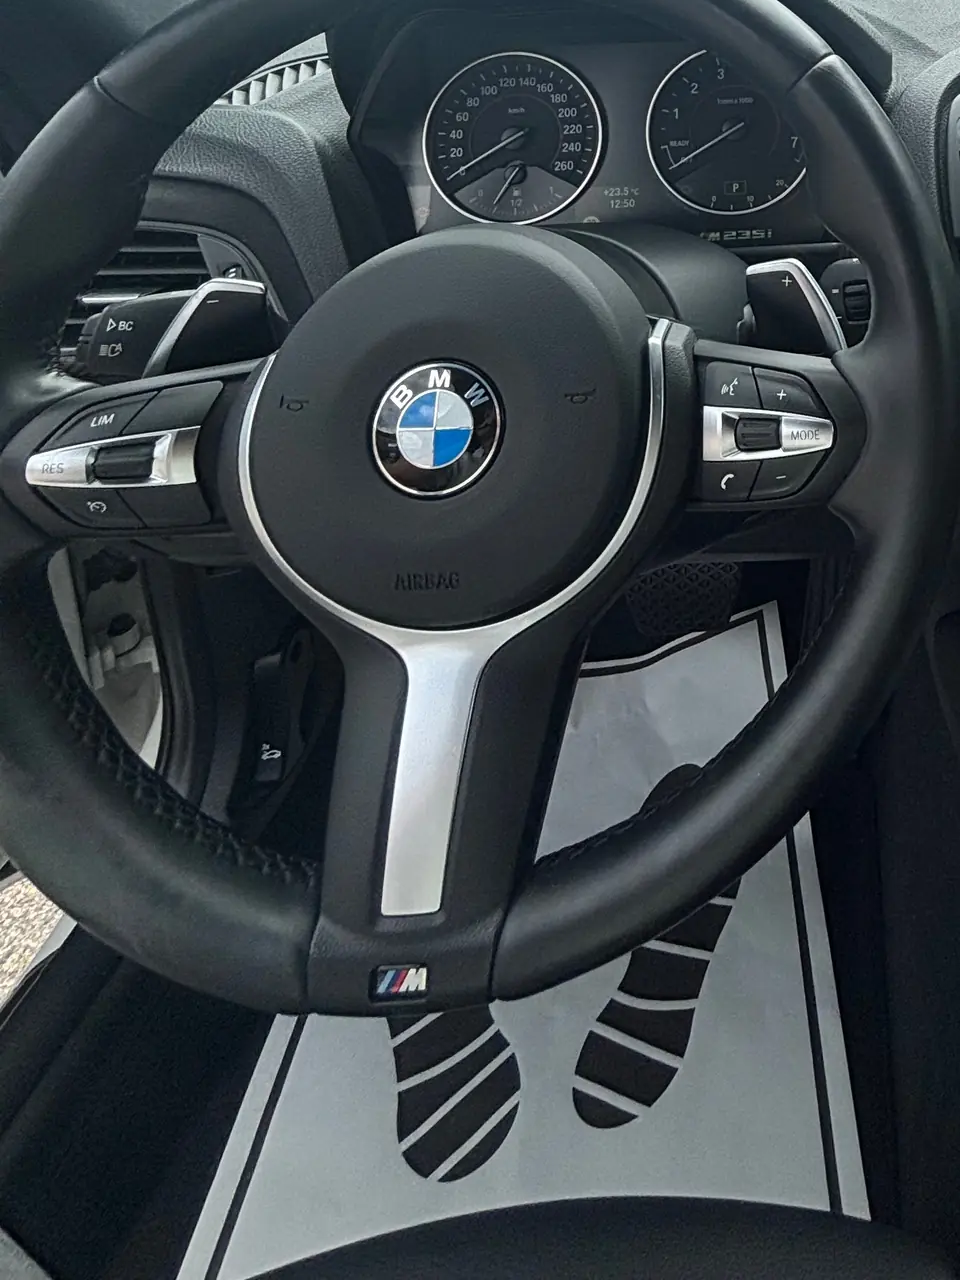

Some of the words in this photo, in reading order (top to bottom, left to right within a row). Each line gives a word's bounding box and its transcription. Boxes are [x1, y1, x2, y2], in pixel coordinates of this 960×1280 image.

[717, 69, 725, 80] 3
[499, 78, 516, 87] 120
[519, 77, 536, 86] 140
[480, 86, 498, 96] 100
[536, 83, 553, 92] 160
[691, 83, 699, 94] 2
[466, 97, 480, 107] 80
[550, 94, 567, 103] 180
[456, 112, 469, 121] 60
[558, 108, 577, 118] 200
[673, 108, 679, 119] 1
[563, 124, 582, 134] 220
[450, 130, 463, 139] 40
[562, 142, 581, 152] 240
[791, 137, 798, 148] 7
[450, 148, 463, 157] 20
[554, 161, 573, 171] 260
[732, 183, 739, 193] P
[610, 199, 636, 209] 12:50
[118, 321, 133, 331] BC
[390, 369, 489, 410] BMW
[90, 413, 115, 427] LIM
[790, 430, 820, 440] MODE
[42, 463, 64, 474] RES
[394, 572, 460, 591] AIRBAG
